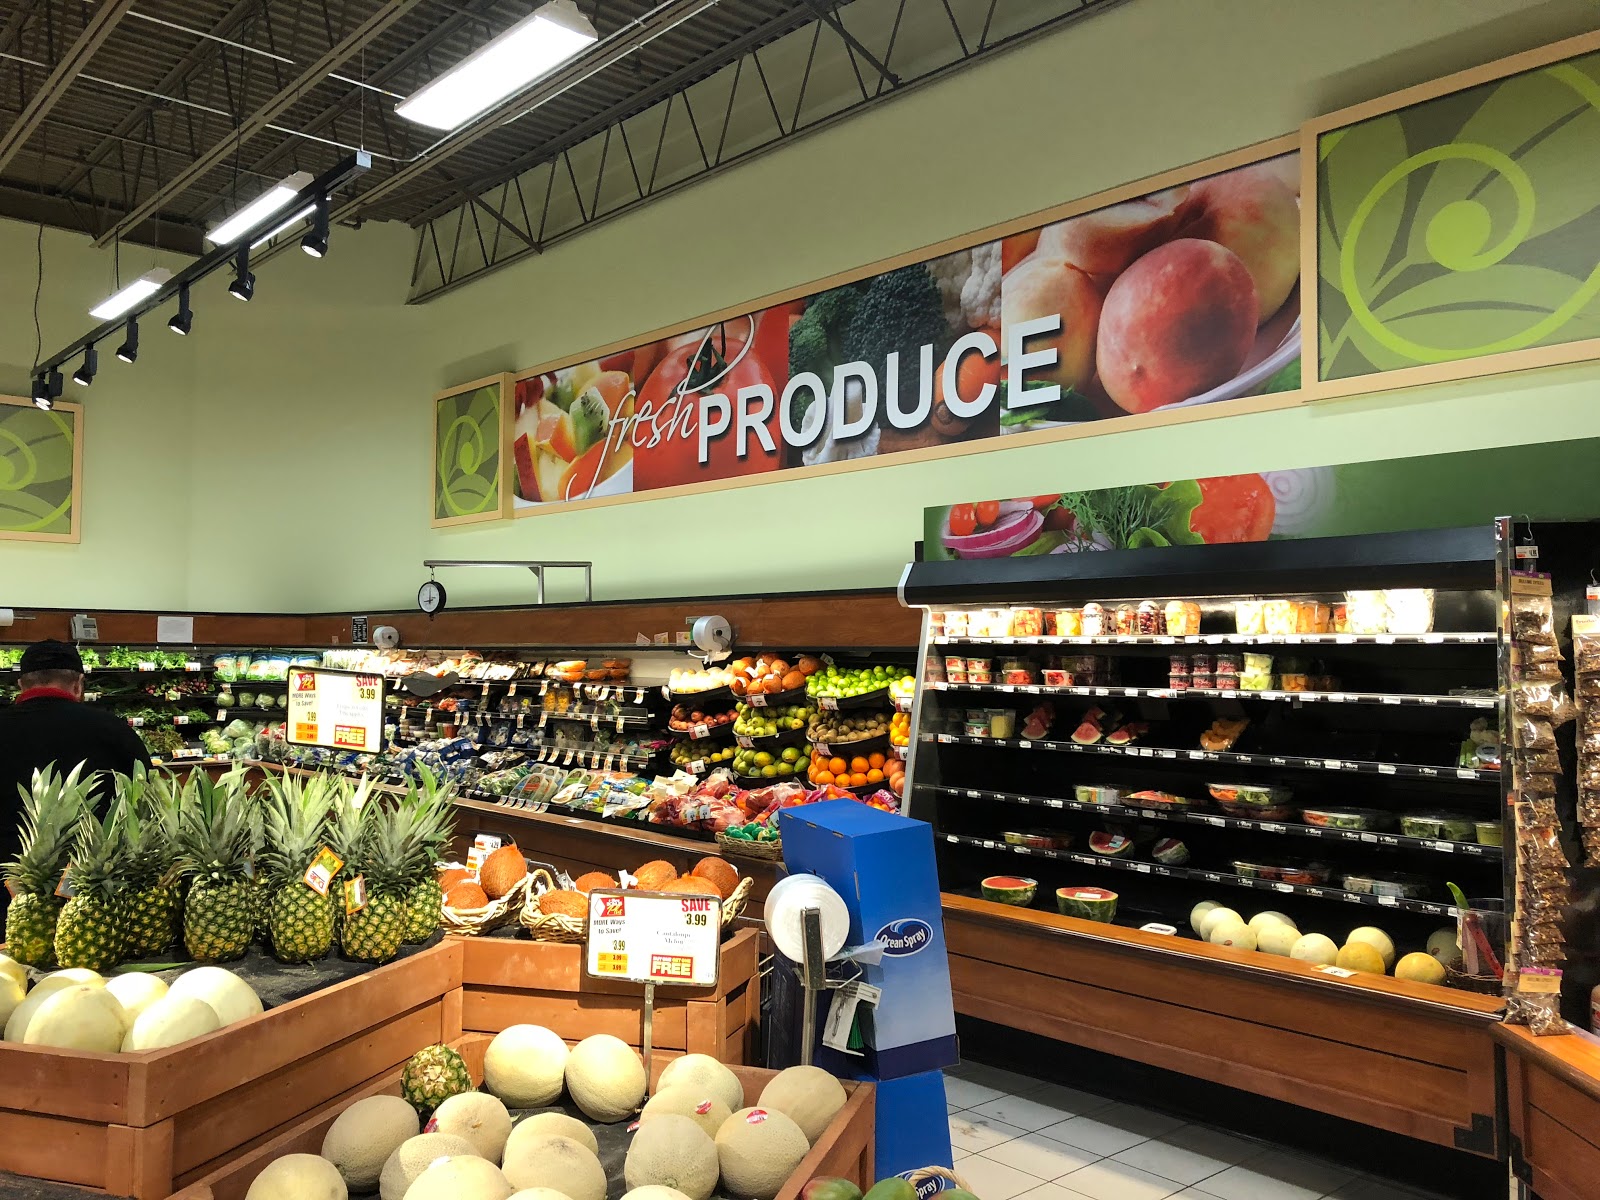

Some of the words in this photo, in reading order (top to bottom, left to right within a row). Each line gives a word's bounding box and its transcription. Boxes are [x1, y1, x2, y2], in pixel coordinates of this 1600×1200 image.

[566, 314, 754, 502] fresh
[698, 314, 1062, 463] PRODUCE
[356, 676, 378, 686] SAVE
[336, 732, 364, 744] FREE
[681, 898, 711, 912] SAVE
[904, 928, 926, 948] Spray
[651, 961, 692, 976] FREE
